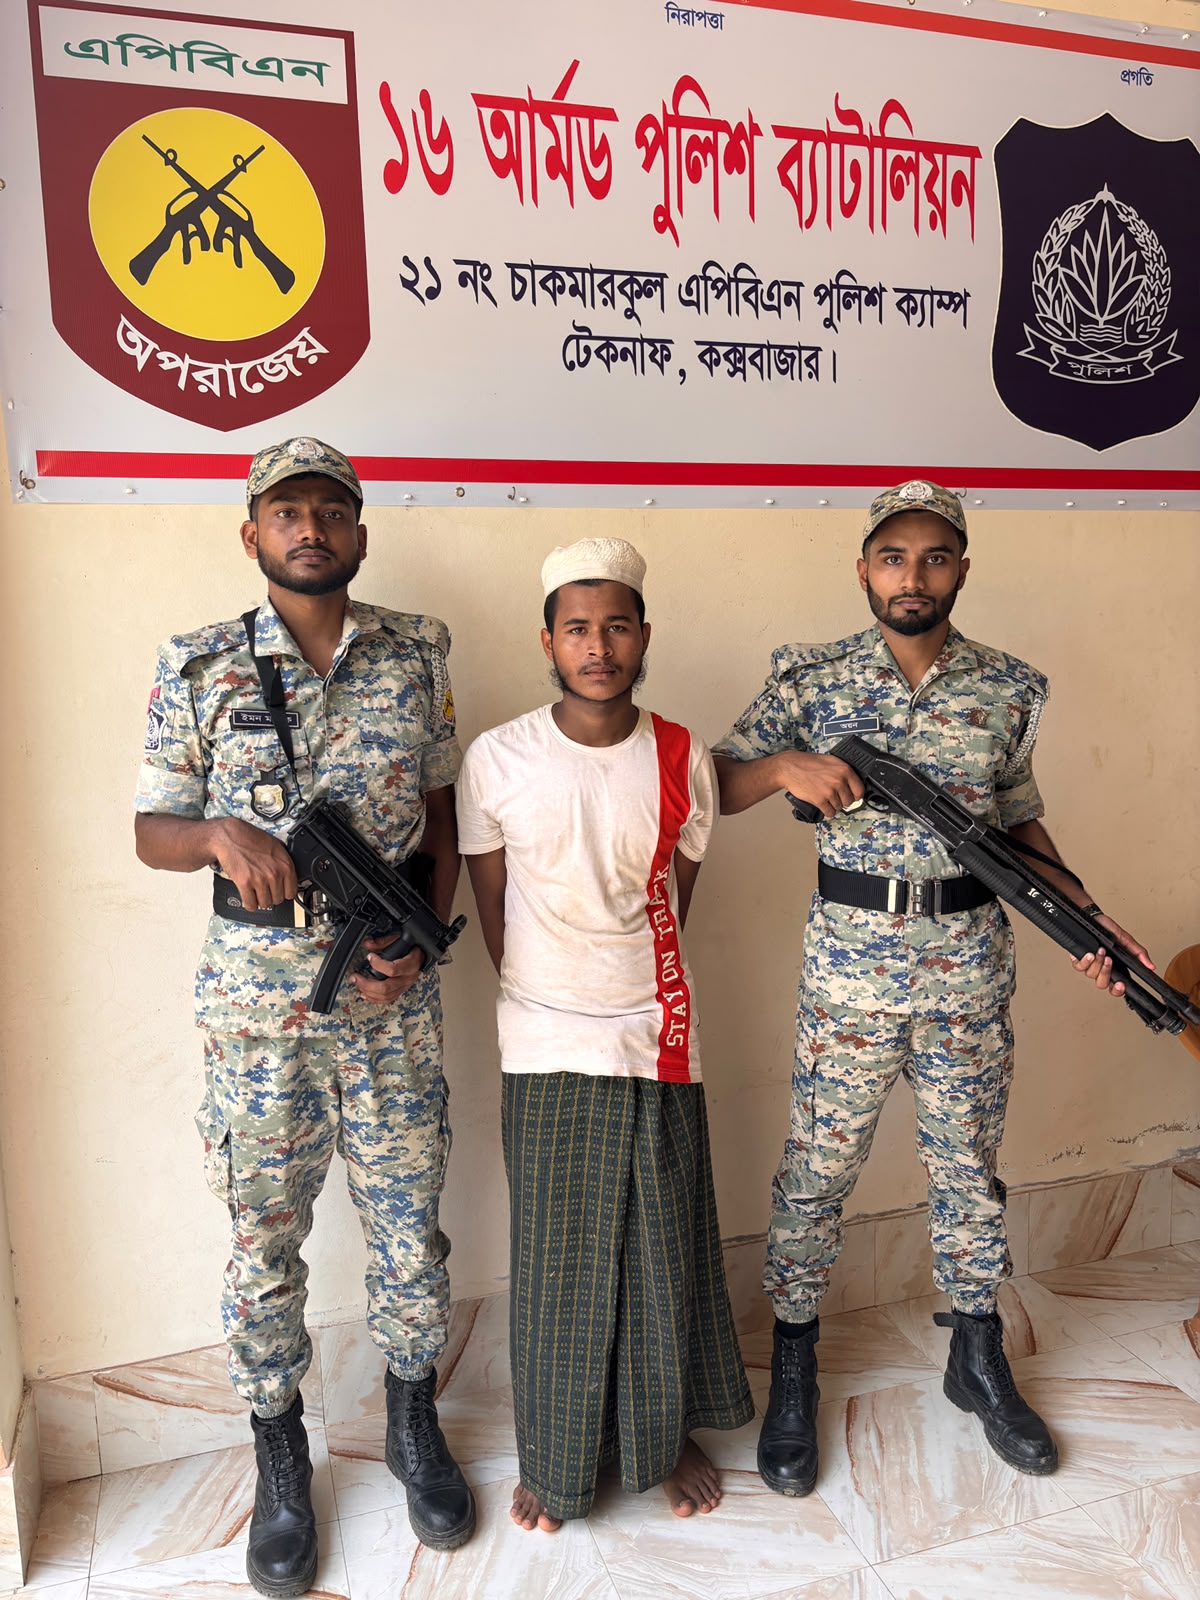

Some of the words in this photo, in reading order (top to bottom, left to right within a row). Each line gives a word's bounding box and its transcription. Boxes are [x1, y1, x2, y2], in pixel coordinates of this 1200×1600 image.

[664, 1, 725, 31] নিরাপত্তা
[64, 33, 331, 88] এপিবিএন
[1120, 66, 1154, 87] প্রগতি
[379, 81, 454, 196] ১৬
[470, 59, 620, 210] আর্মড
[635, 74, 764, 248] পুলিশ
[771, 92, 983, 246] ব্যাটালিয়ন
[399, 255, 442, 306] ২১
[453, 258, 498, 309] নং
[504, 259, 669, 327] চাকমারকুল
[678, 260, 805, 322] এপিবিএন
[813, 269, 888, 334] পুলিশ
[892, 285, 971, 330] ক্যাম্প
[116, 313, 330, 399] অপরাজেয়
[1067, 361, 1134, 379] পুলিশ
[661, 950, 678, 983] ON
[662, 989, 687, 1047] STAY
